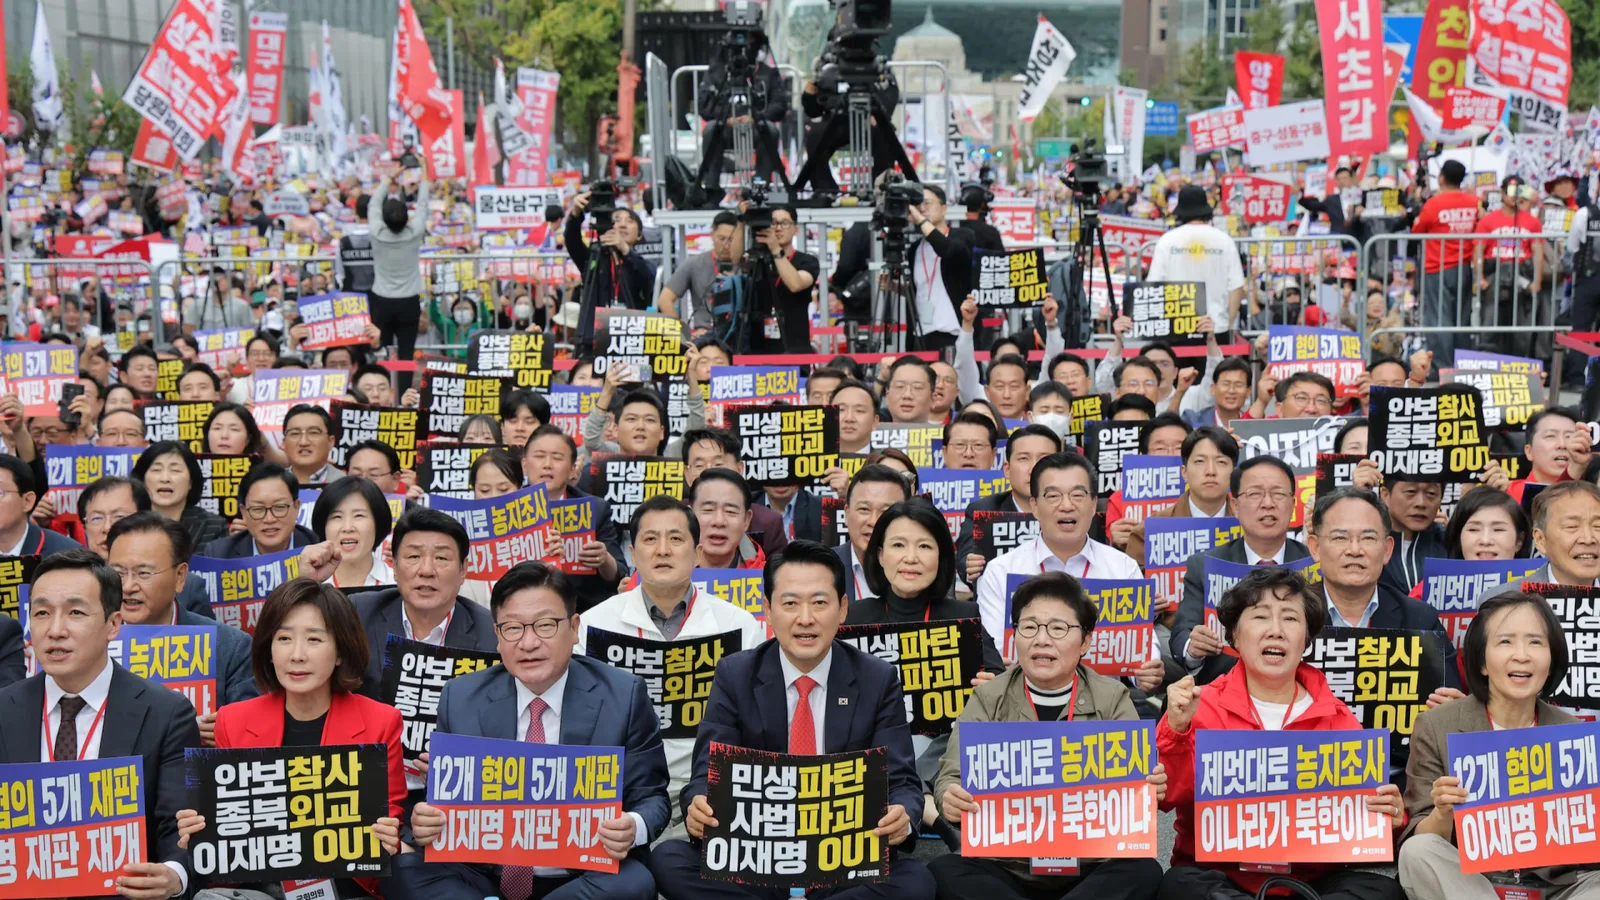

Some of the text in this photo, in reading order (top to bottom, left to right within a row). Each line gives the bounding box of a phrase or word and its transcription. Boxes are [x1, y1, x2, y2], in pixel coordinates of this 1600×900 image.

[1334, 0, 1376, 141] 서초갑
[979, 270, 1039, 288] 종북외교
[980, 250, 1038, 271] 안보참사
[1133, 283, 1197, 303] 안보참사
[478, 334, 544, 352] 안보참사
[607, 336, 681, 355] 사법파괴
[609, 316, 682, 336] 민생파탄
[477, 352, 542, 370] 종북외교
[432, 376, 501, 396] 민생파탄
[711, 370, 799, 399] 제멋대로 농지조사
[341, 409, 418, 431] 민생파탄
[430, 396, 500, 414] 사법파괴
[739, 411, 826, 435] 민생파탄
[1388, 394, 1476, 422] 안보참사
[740, 433, 825, 457] 사법파괴
[1386, 421, 1481, 449] 종북외교
[47, 458, 71, 486] 12개
[75, 455, 103, 484] 혐의
[605, 460, 685, 483] 민생파탄
[1371, 448, 1444, 475] 이재명
[1450, 446, 1491, 472] OUT
[1125, 465, 1182, 500] 제멋대로
[491, 487, 548, 538] 농지조사
[221, 567, 254, 601] 혐의
[256, 562, 283, 595] 5개
[130, 632, 212, 681] 농지조사
[214, 750, 363, 799] 안보참사
[432, 754, 620, 801] 12개 혐의 5개 재판
[966, 727, 1151, 790] 제멋대로 농지조사
[1200, 736, 1386, 797] 제멋대로 농지조사
[1453, 734, 1599, 804] 12개 혐의 5개
[41, 772, 83, 825] 5개
[89, 764, 139, 818] 재판
[731, 757, 867, 800] 민생파탄
[216, 790, 362, 837] 종북외교
[511, 807, 561, 850] 재판
[730, 795, 865, 838] 사법파괴
[1062, 785, 1152, 841] 북한이냐
[1201, 800, 1290, 853] 이나라가
[1461, 793, 1597, 861] 이재명 재판
[25, 832, 80, 881] 재판
[87, 821, 141, 874] 재개
[193, 826, 382, 876] 이재명 OUT
[706, 830, 881, 875] 이재명 OUT
